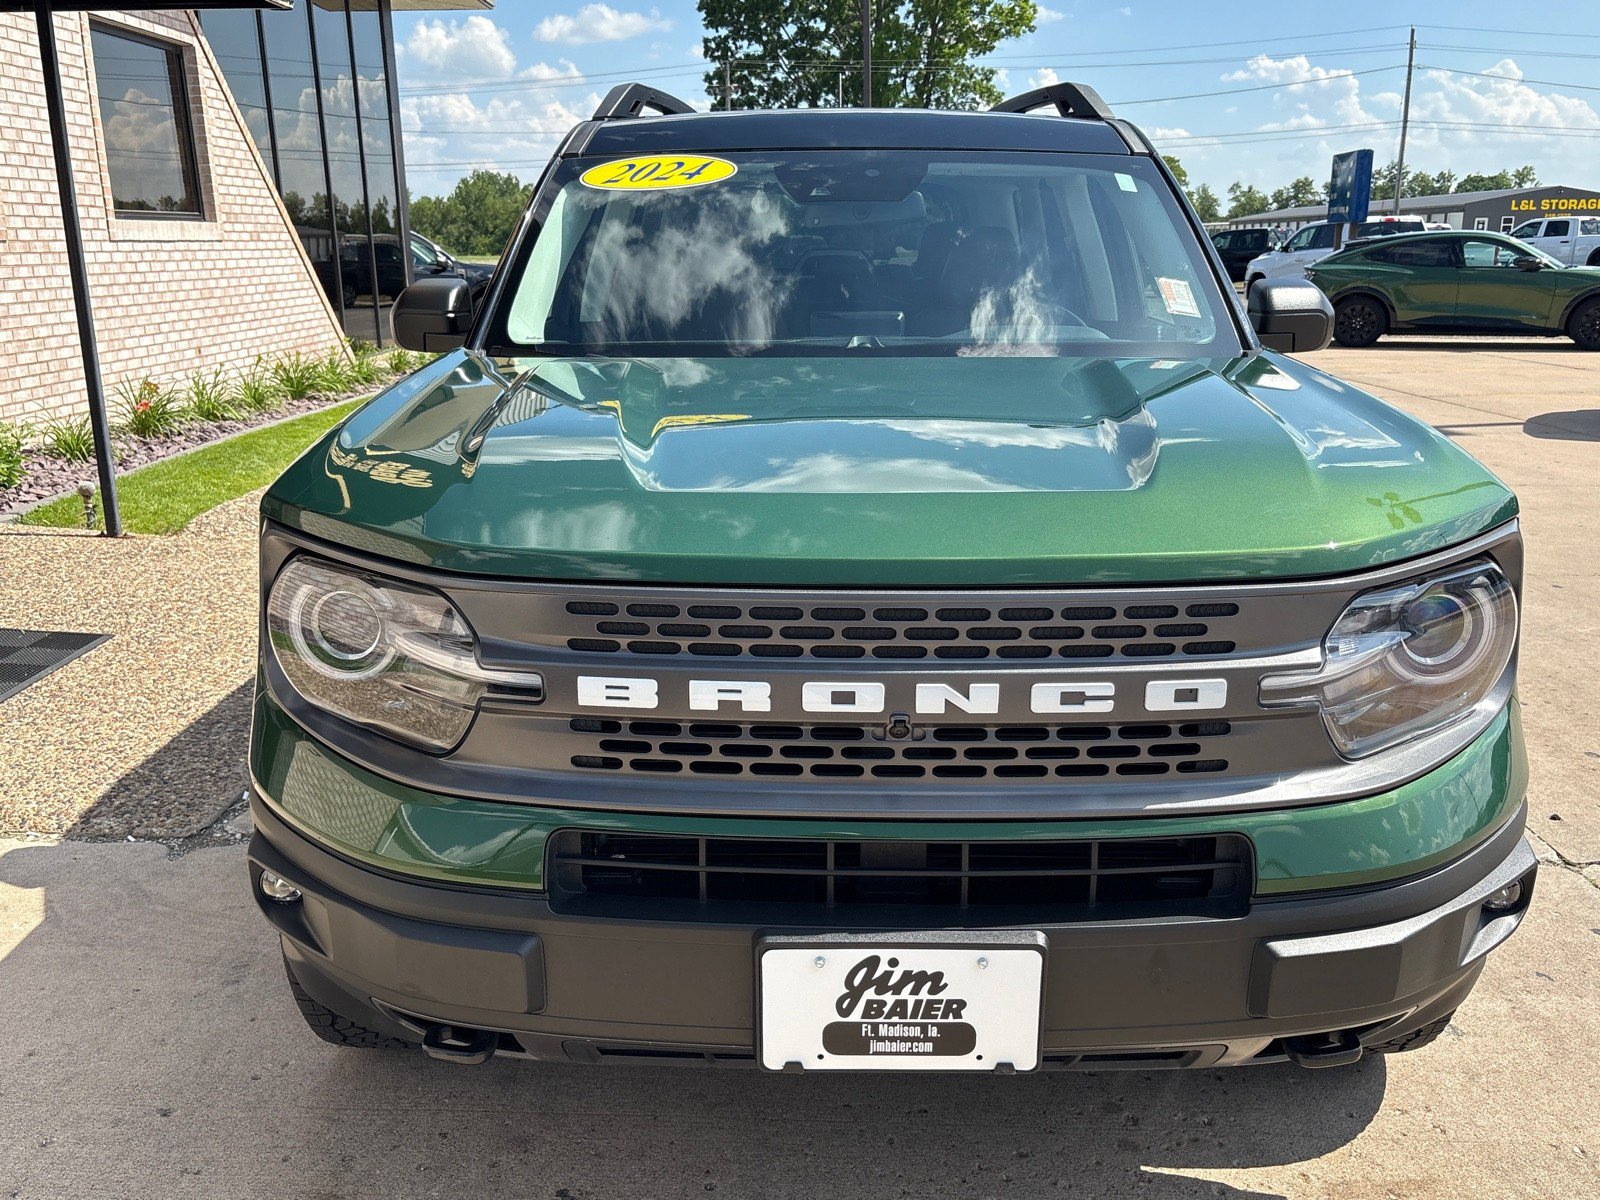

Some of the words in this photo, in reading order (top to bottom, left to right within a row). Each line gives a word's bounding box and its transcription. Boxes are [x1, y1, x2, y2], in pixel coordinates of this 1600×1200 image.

[601, 160, 716, 185] 2024
[1511, 199, 1537, 211] L&L
[577, 675, 1227, 714] BRONCO
[835, 954, 949, 1018] Jim
[860, 998, 968, 1020] BAIER
[861, 1024, 875, 1037] Ft.
[878, 1024, 924, 1038] Madison,
[869, 1039, 933, 1055] jimbaier.com
